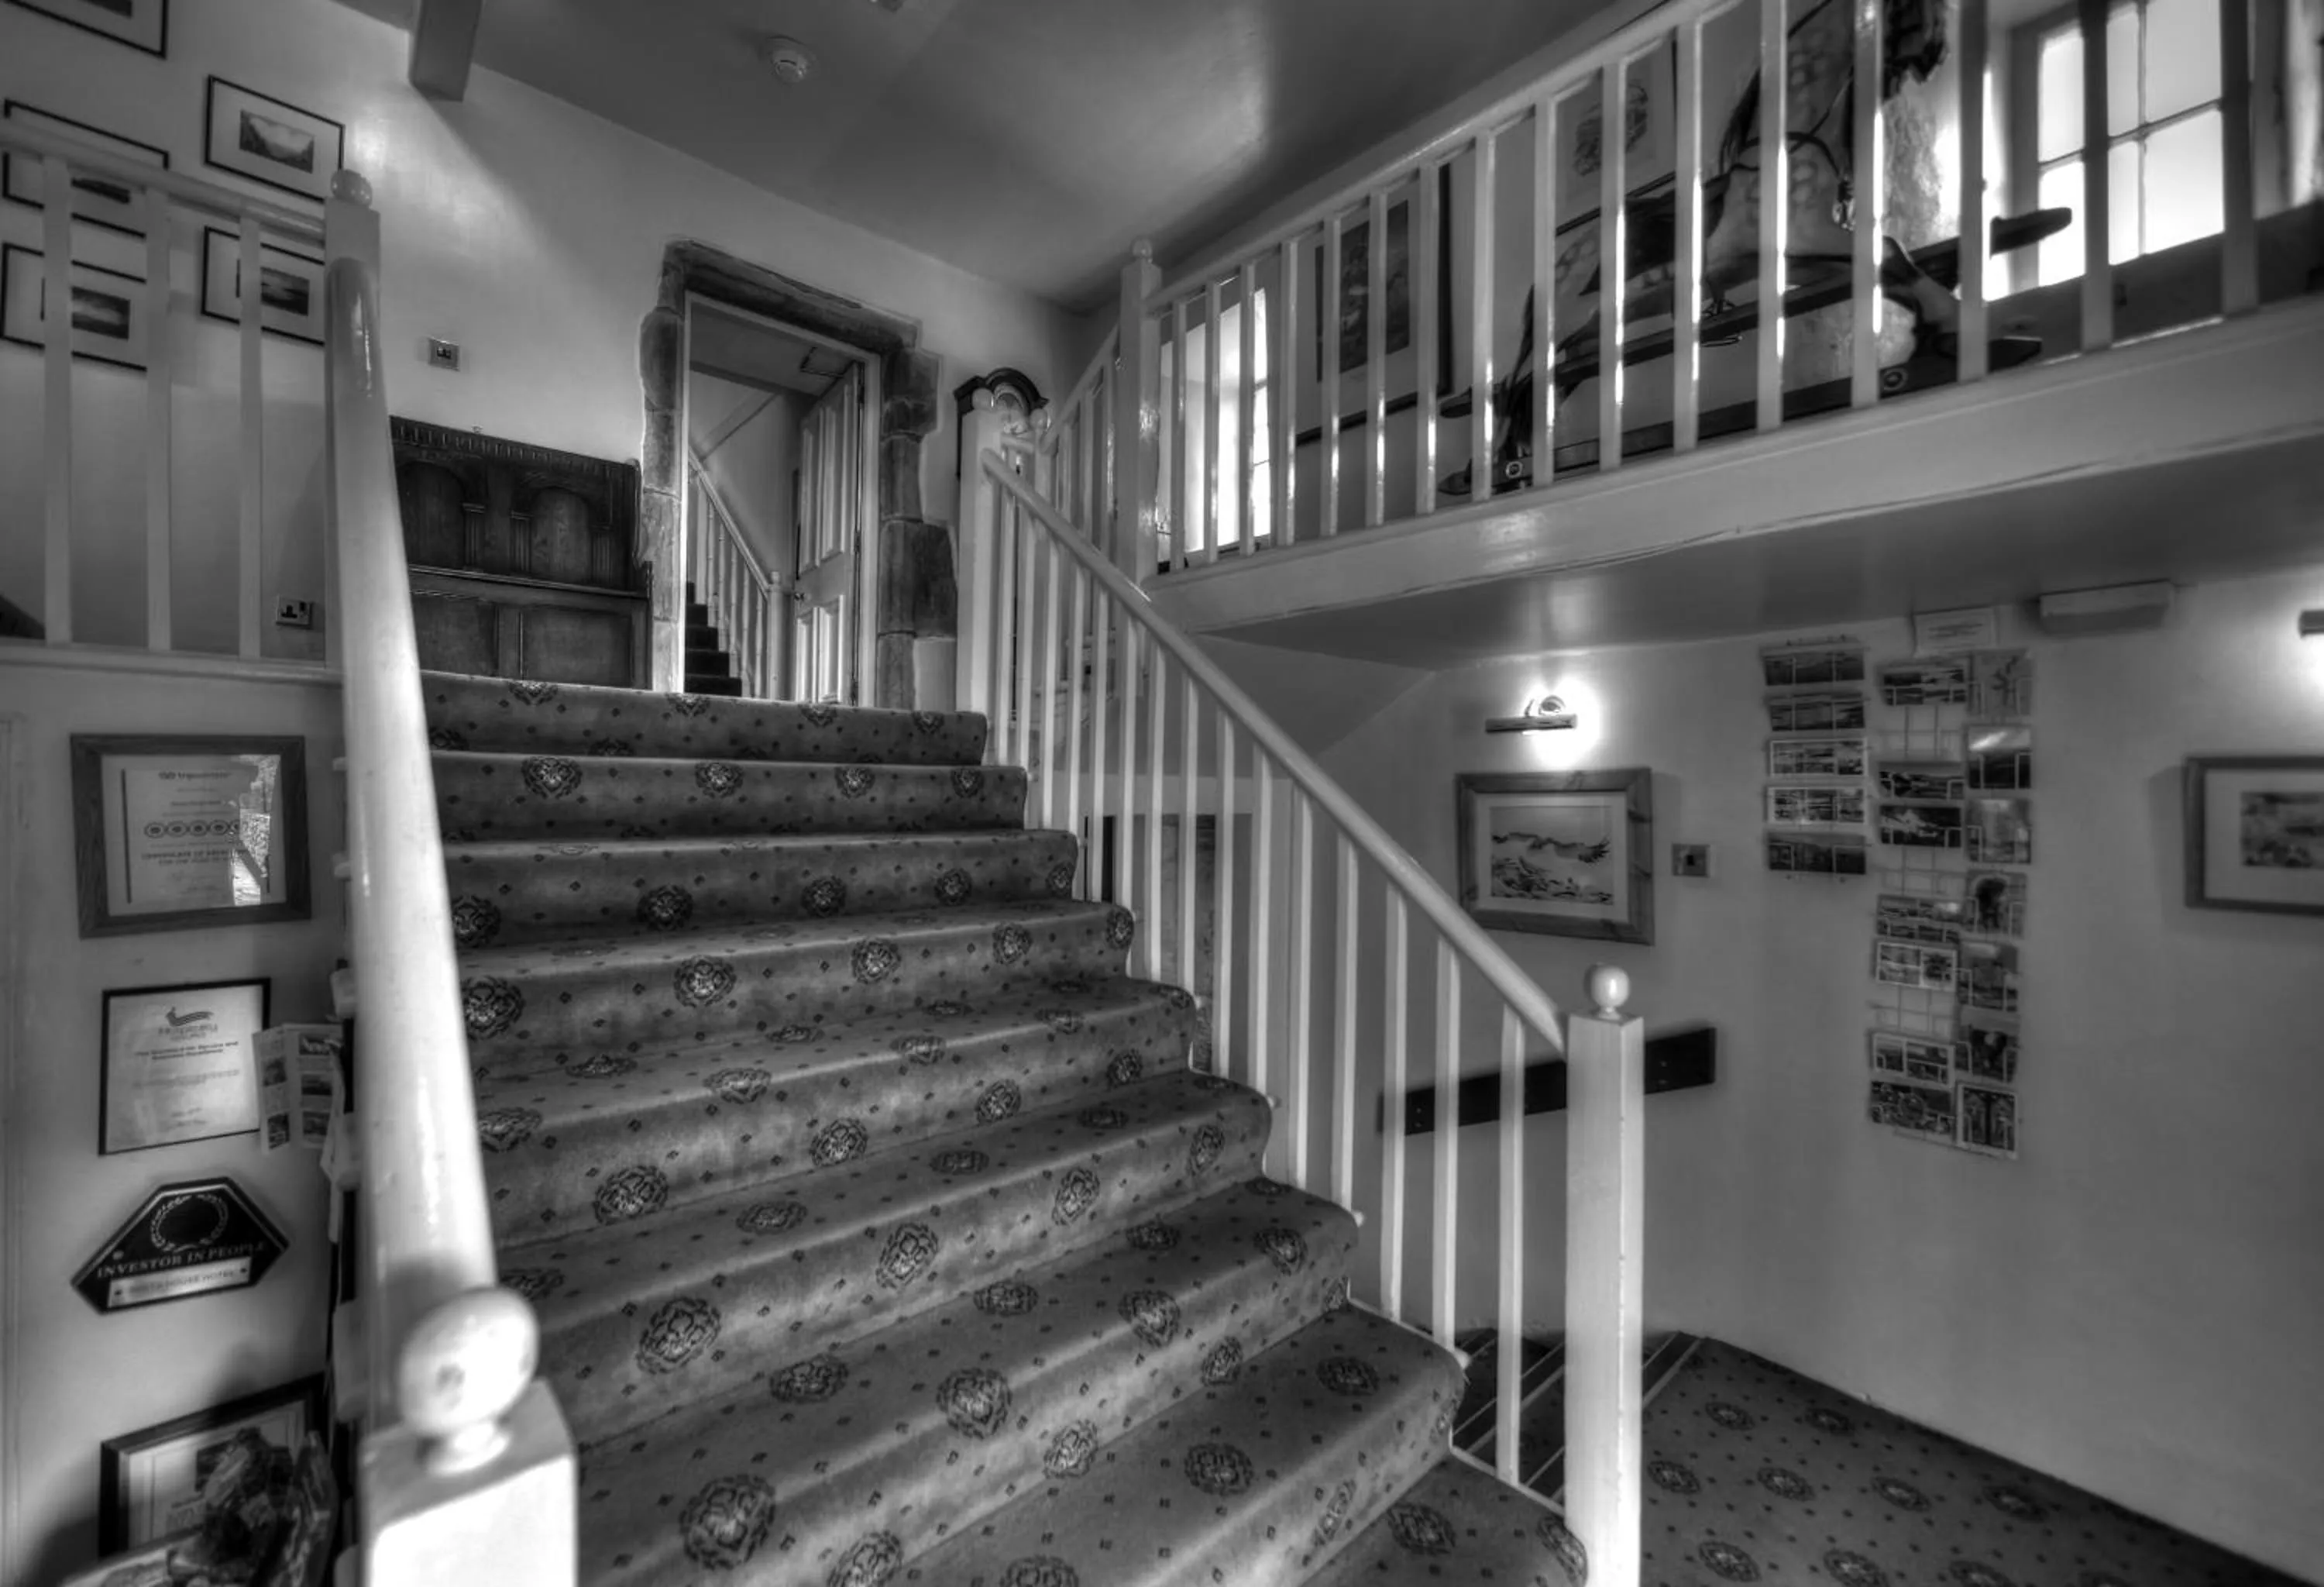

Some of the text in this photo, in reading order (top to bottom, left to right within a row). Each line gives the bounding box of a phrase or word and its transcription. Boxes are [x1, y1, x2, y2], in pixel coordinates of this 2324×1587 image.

[97, 1241, 265, 1278] INVESTOR IN PEOPLE
